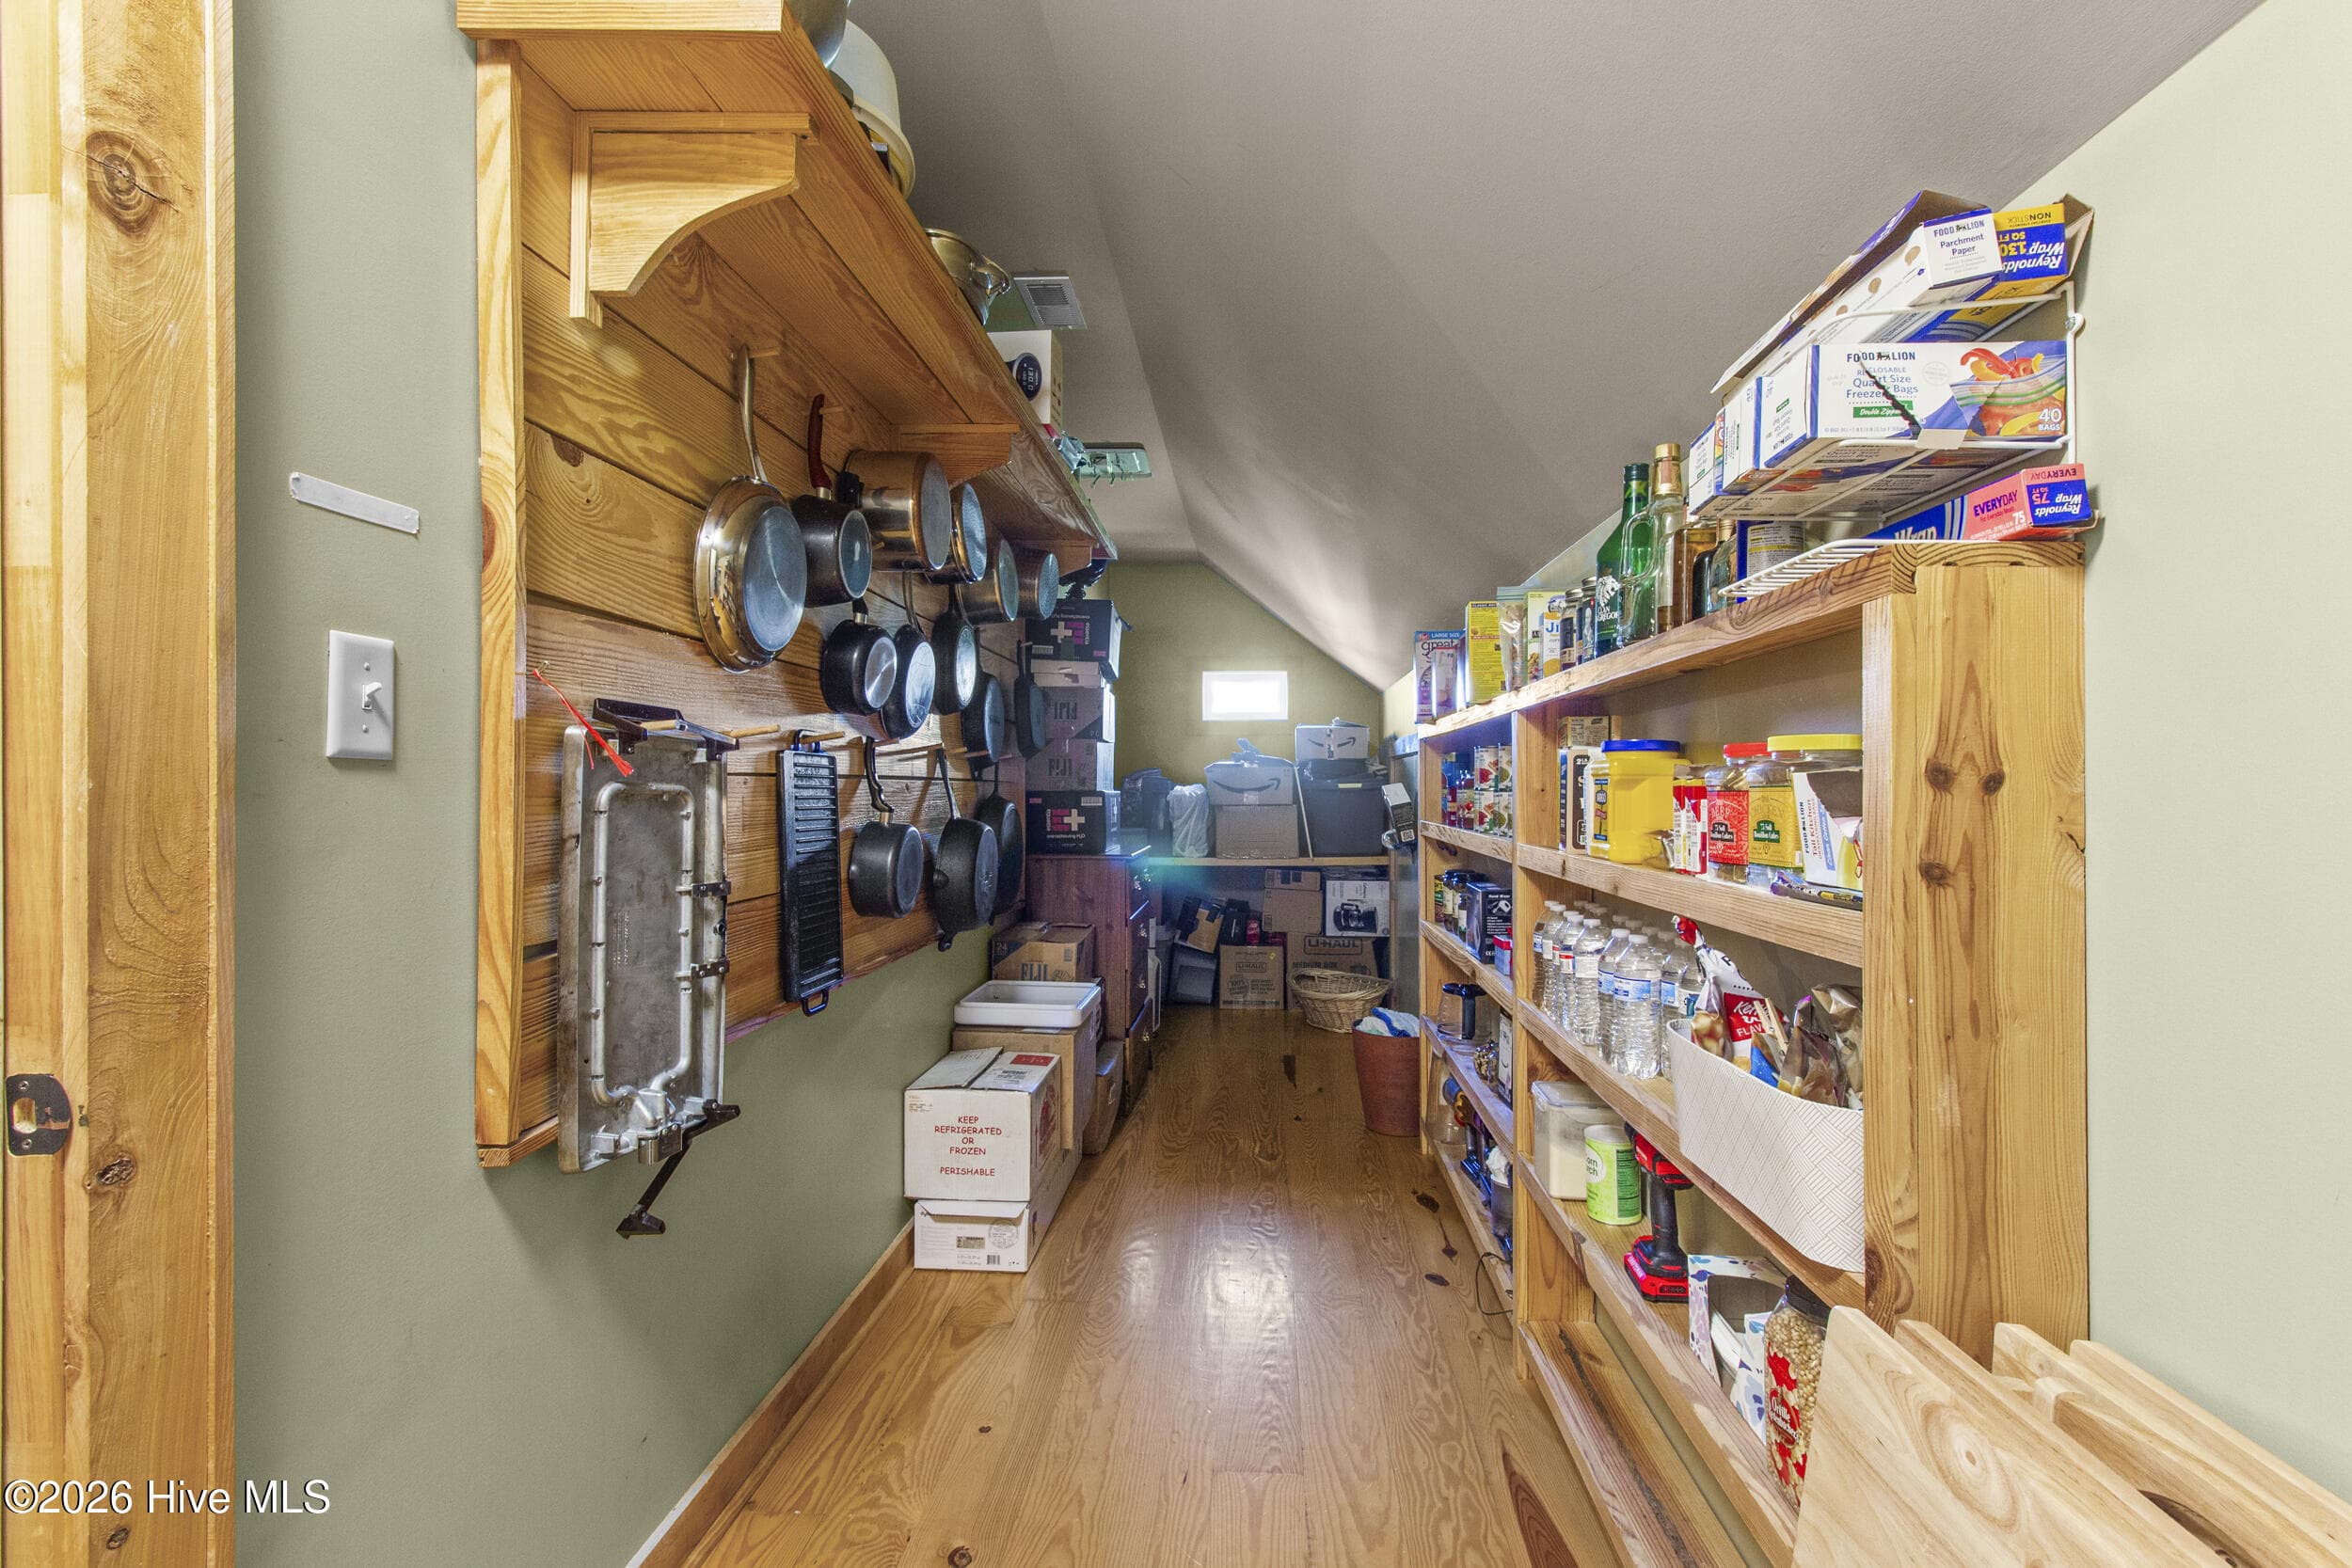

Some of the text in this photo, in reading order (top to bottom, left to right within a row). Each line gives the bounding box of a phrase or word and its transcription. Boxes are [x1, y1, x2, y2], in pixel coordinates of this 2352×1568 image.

[1933, 219, 1985, 238] FOOD LION
[1940, 233, 1984, 249] Parchment
[1998, 231, 2026, 242] SQ FT
[1952, 245, 1976, 256] Paper
[2000, 242, 2027, 257] 130
[2029, 242, 2065, 256] Wrap
[2001, 255, 2063, 274] Reynolds
[1846, 352, 1915, 363] FOOD LION
[1890, 374, 1912, 383] Size
[1893, 384, 1919, 395] Bags
[2038, 407, 2062, 422] 40
[2031, 468, 2077, 481] EVERYDAY
[1973, 490, 2018, 517] EVERYDAY
[2033, 492, 2050, 505] 75
[2056, 493, 2083, 503] Wrap
[2034, 504, 2082, 517] Reynolds
[2012, 510, 2026, 525] 75
[1421, 639, 1454, 656] great
[1021, 963, 1048, 981] FIJI
[934, 1125, 1002, 1135] REFRIGERATED
[949, 1147, 986, 1156] FROZEN
[940, 1167, 995, 1176] PERISHABLE
